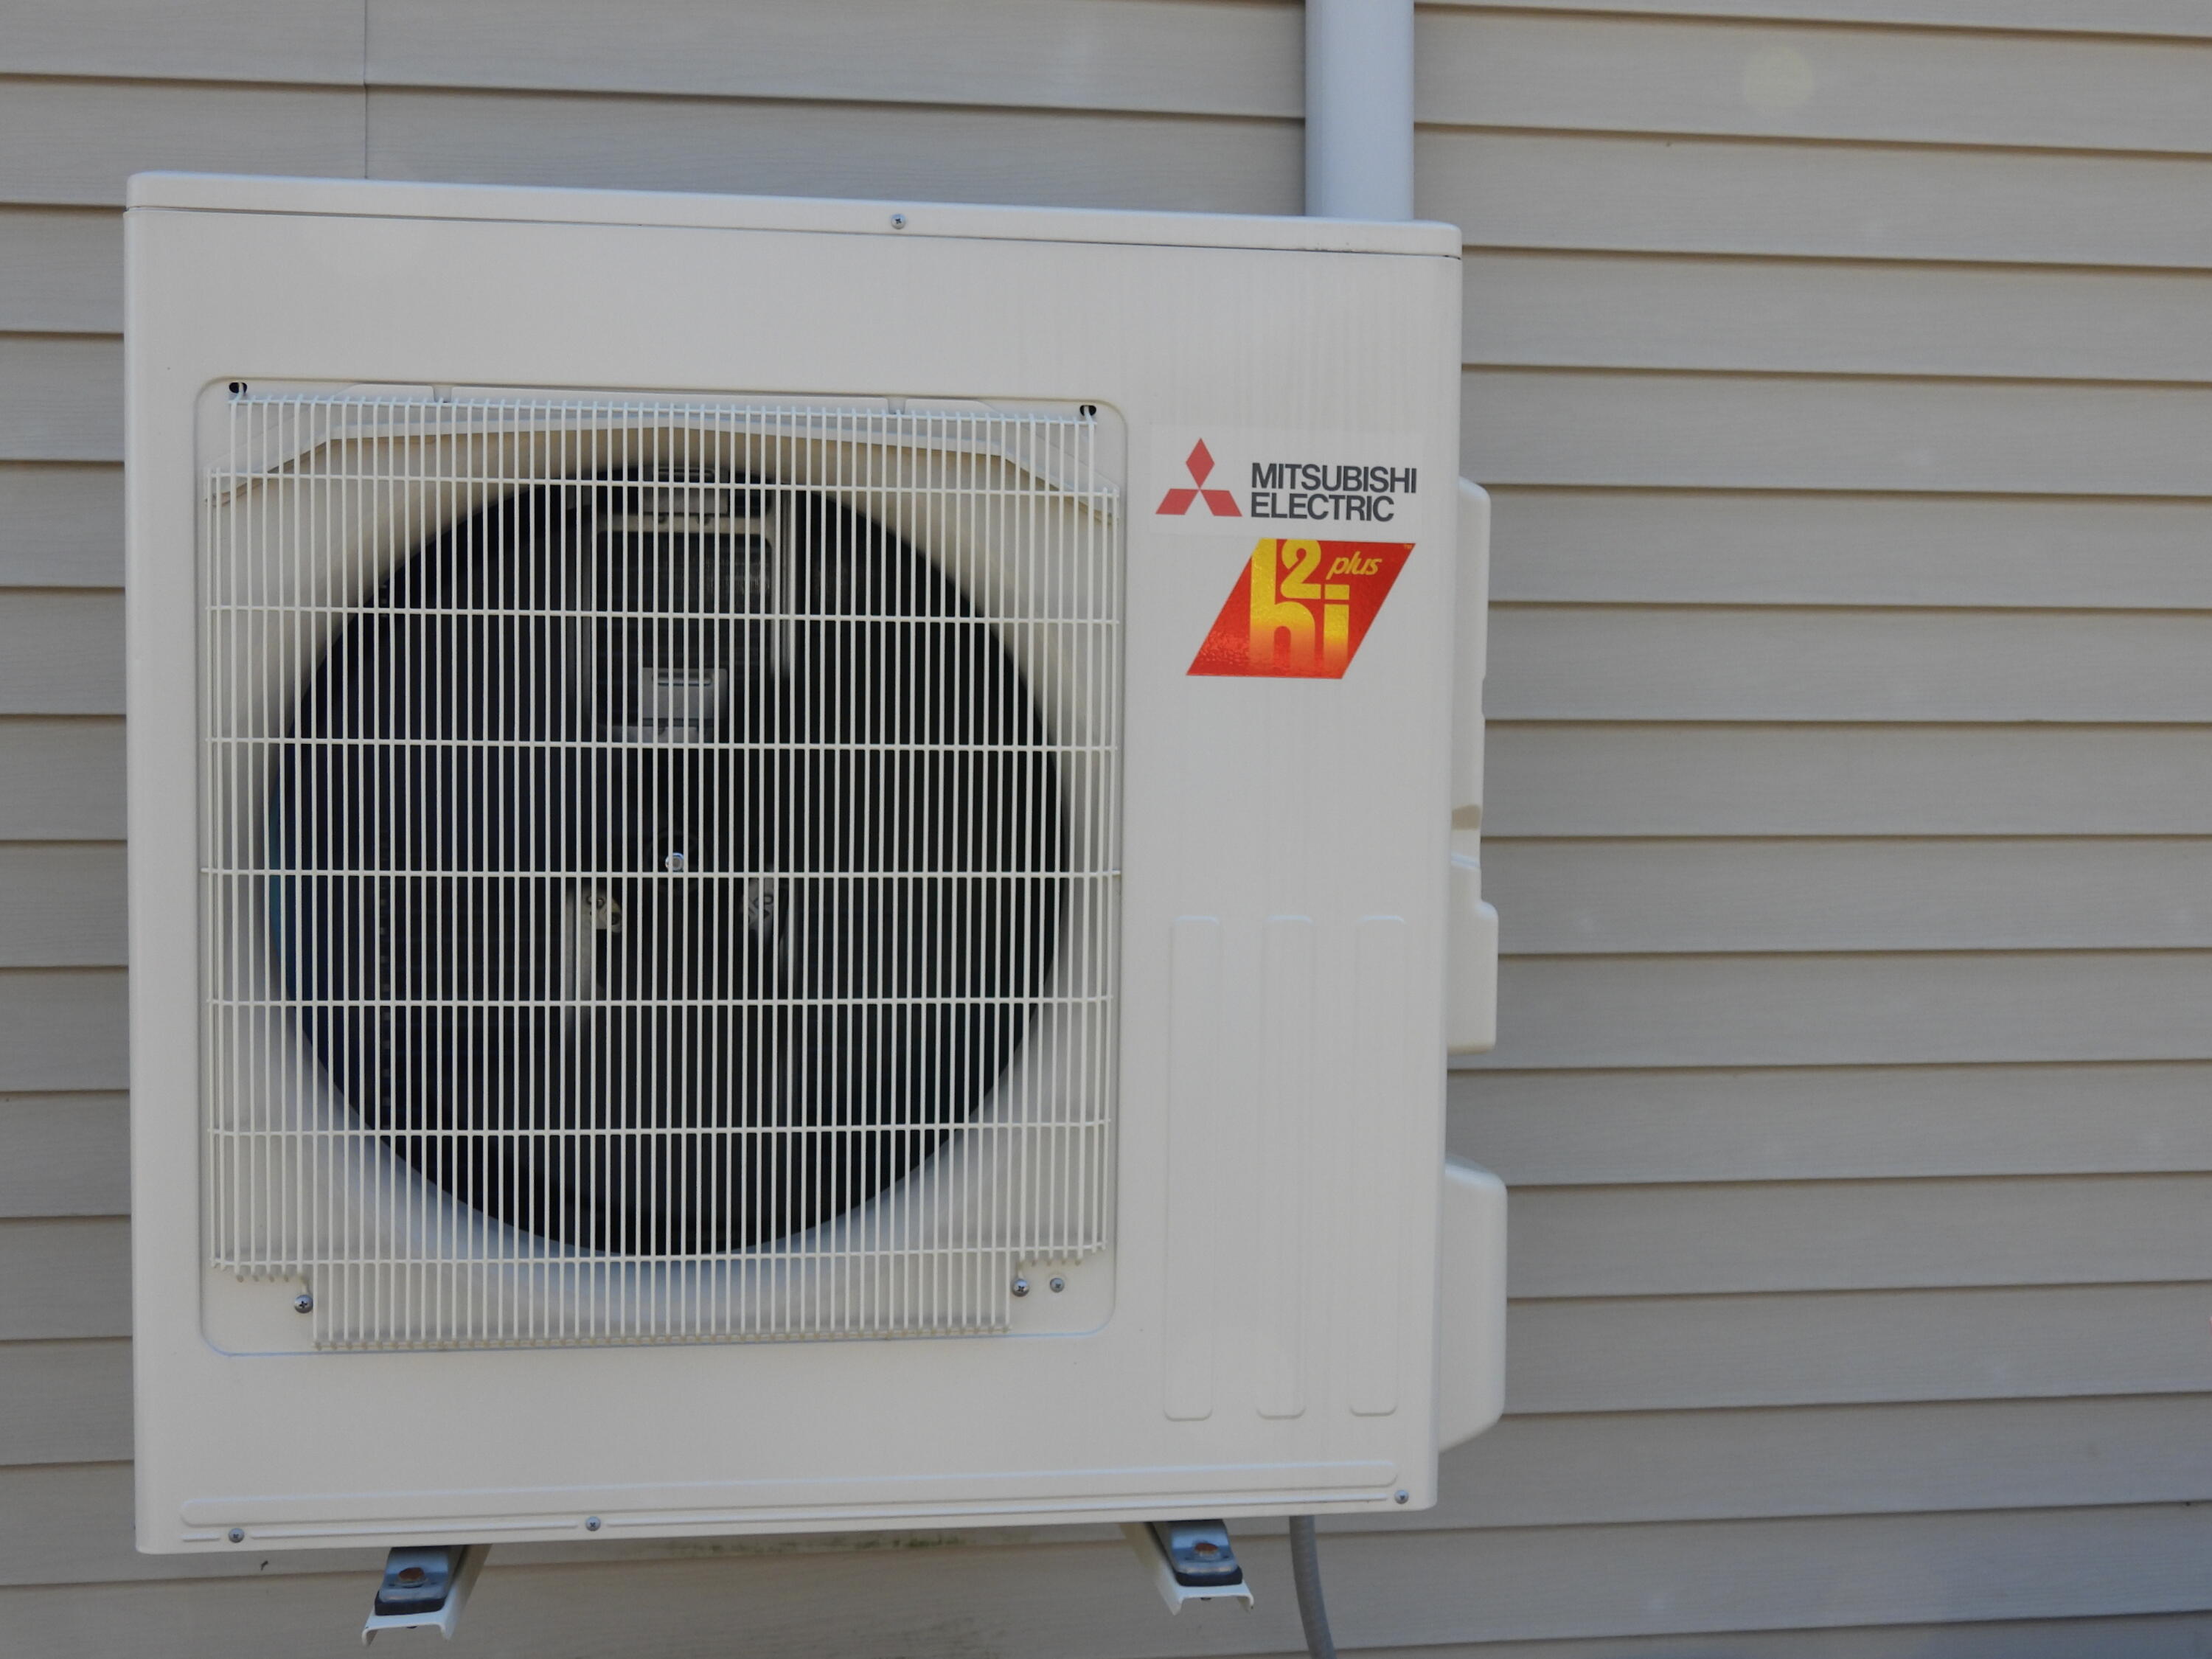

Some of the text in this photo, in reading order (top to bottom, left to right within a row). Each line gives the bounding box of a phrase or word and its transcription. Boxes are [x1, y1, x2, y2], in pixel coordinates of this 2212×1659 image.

[1252, 462, 1417, 493] MITSUBISHI
[1251, 492, 1394, 522] ELECTRIC
[1326, 551, 1382, 580] plus
